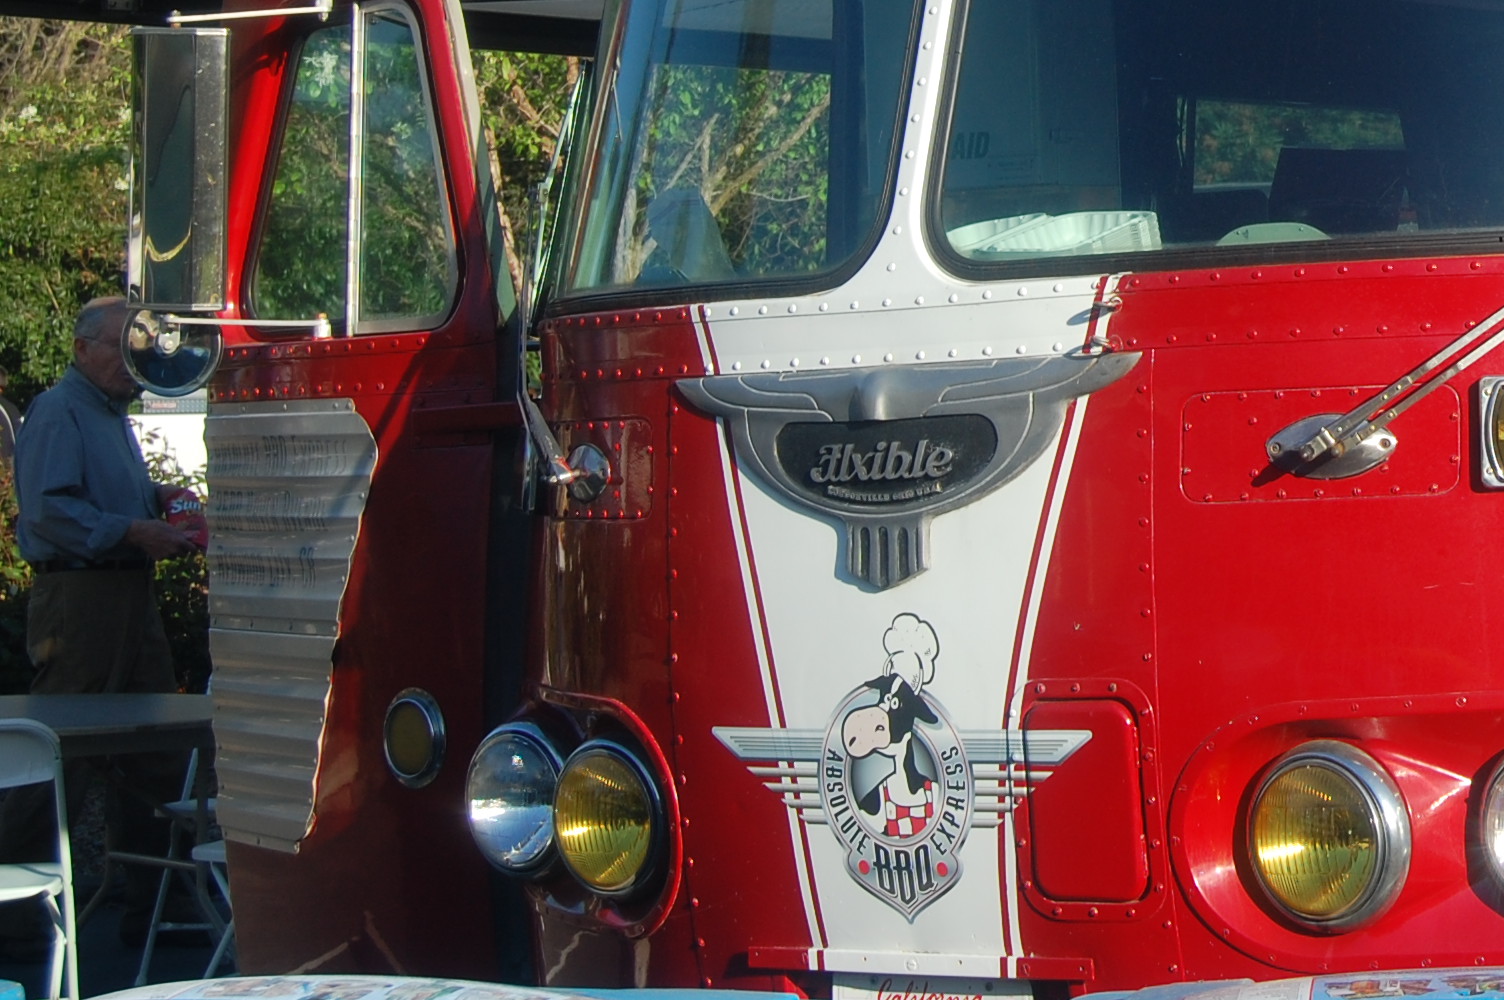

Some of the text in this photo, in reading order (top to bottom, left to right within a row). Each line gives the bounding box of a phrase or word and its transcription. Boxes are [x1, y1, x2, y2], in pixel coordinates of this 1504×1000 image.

[825, 747, 871, 856] ABSOLUTE
[930, 745, 966, 856] EXPRESS
[872, 842, 939, 906] BBQ
